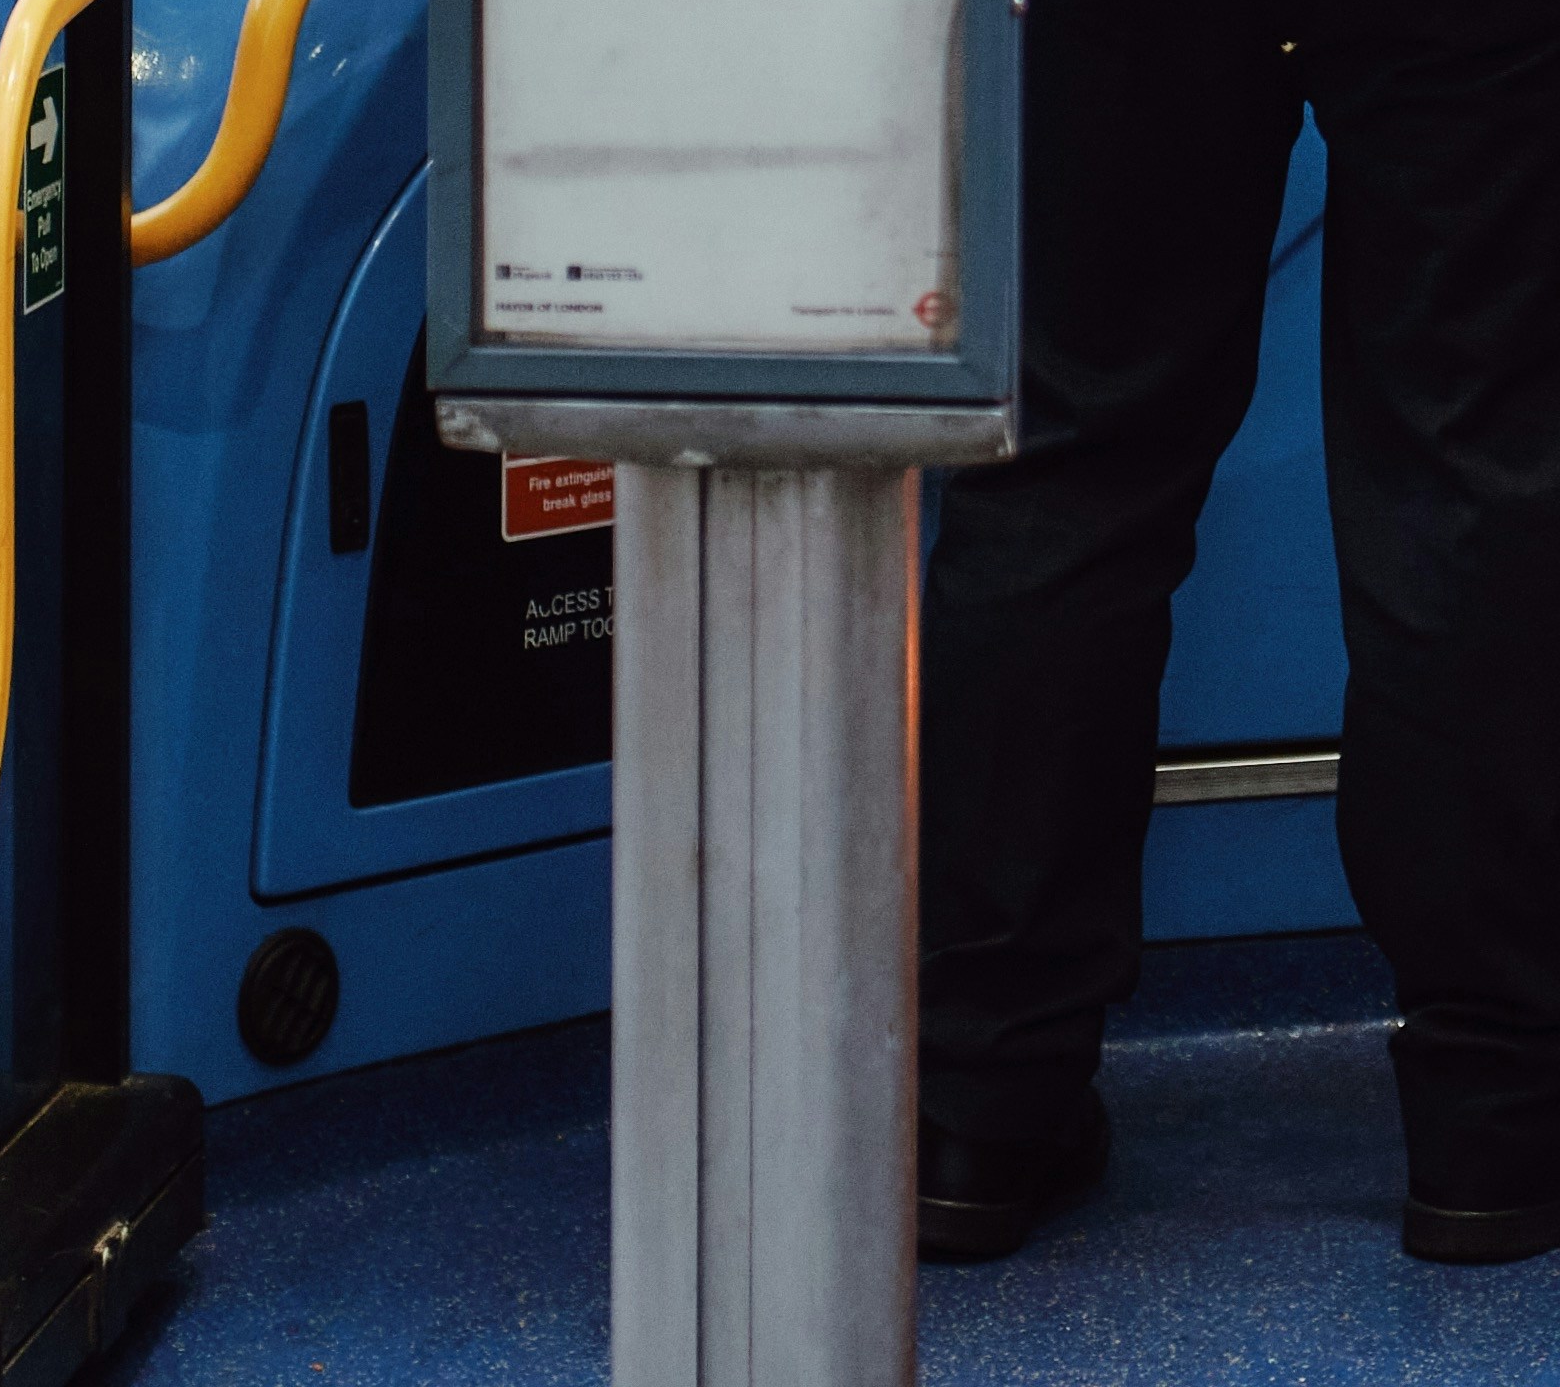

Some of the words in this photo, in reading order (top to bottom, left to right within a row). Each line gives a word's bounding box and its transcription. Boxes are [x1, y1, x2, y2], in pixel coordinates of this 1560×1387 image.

[528, 476, 552, 492] Fire
[555, 465, 614, 488] extinguish
[542, 494, 577, 512] break
[580, 489, 613, 509] glass
[523, 620, 577, 650] RAMP
